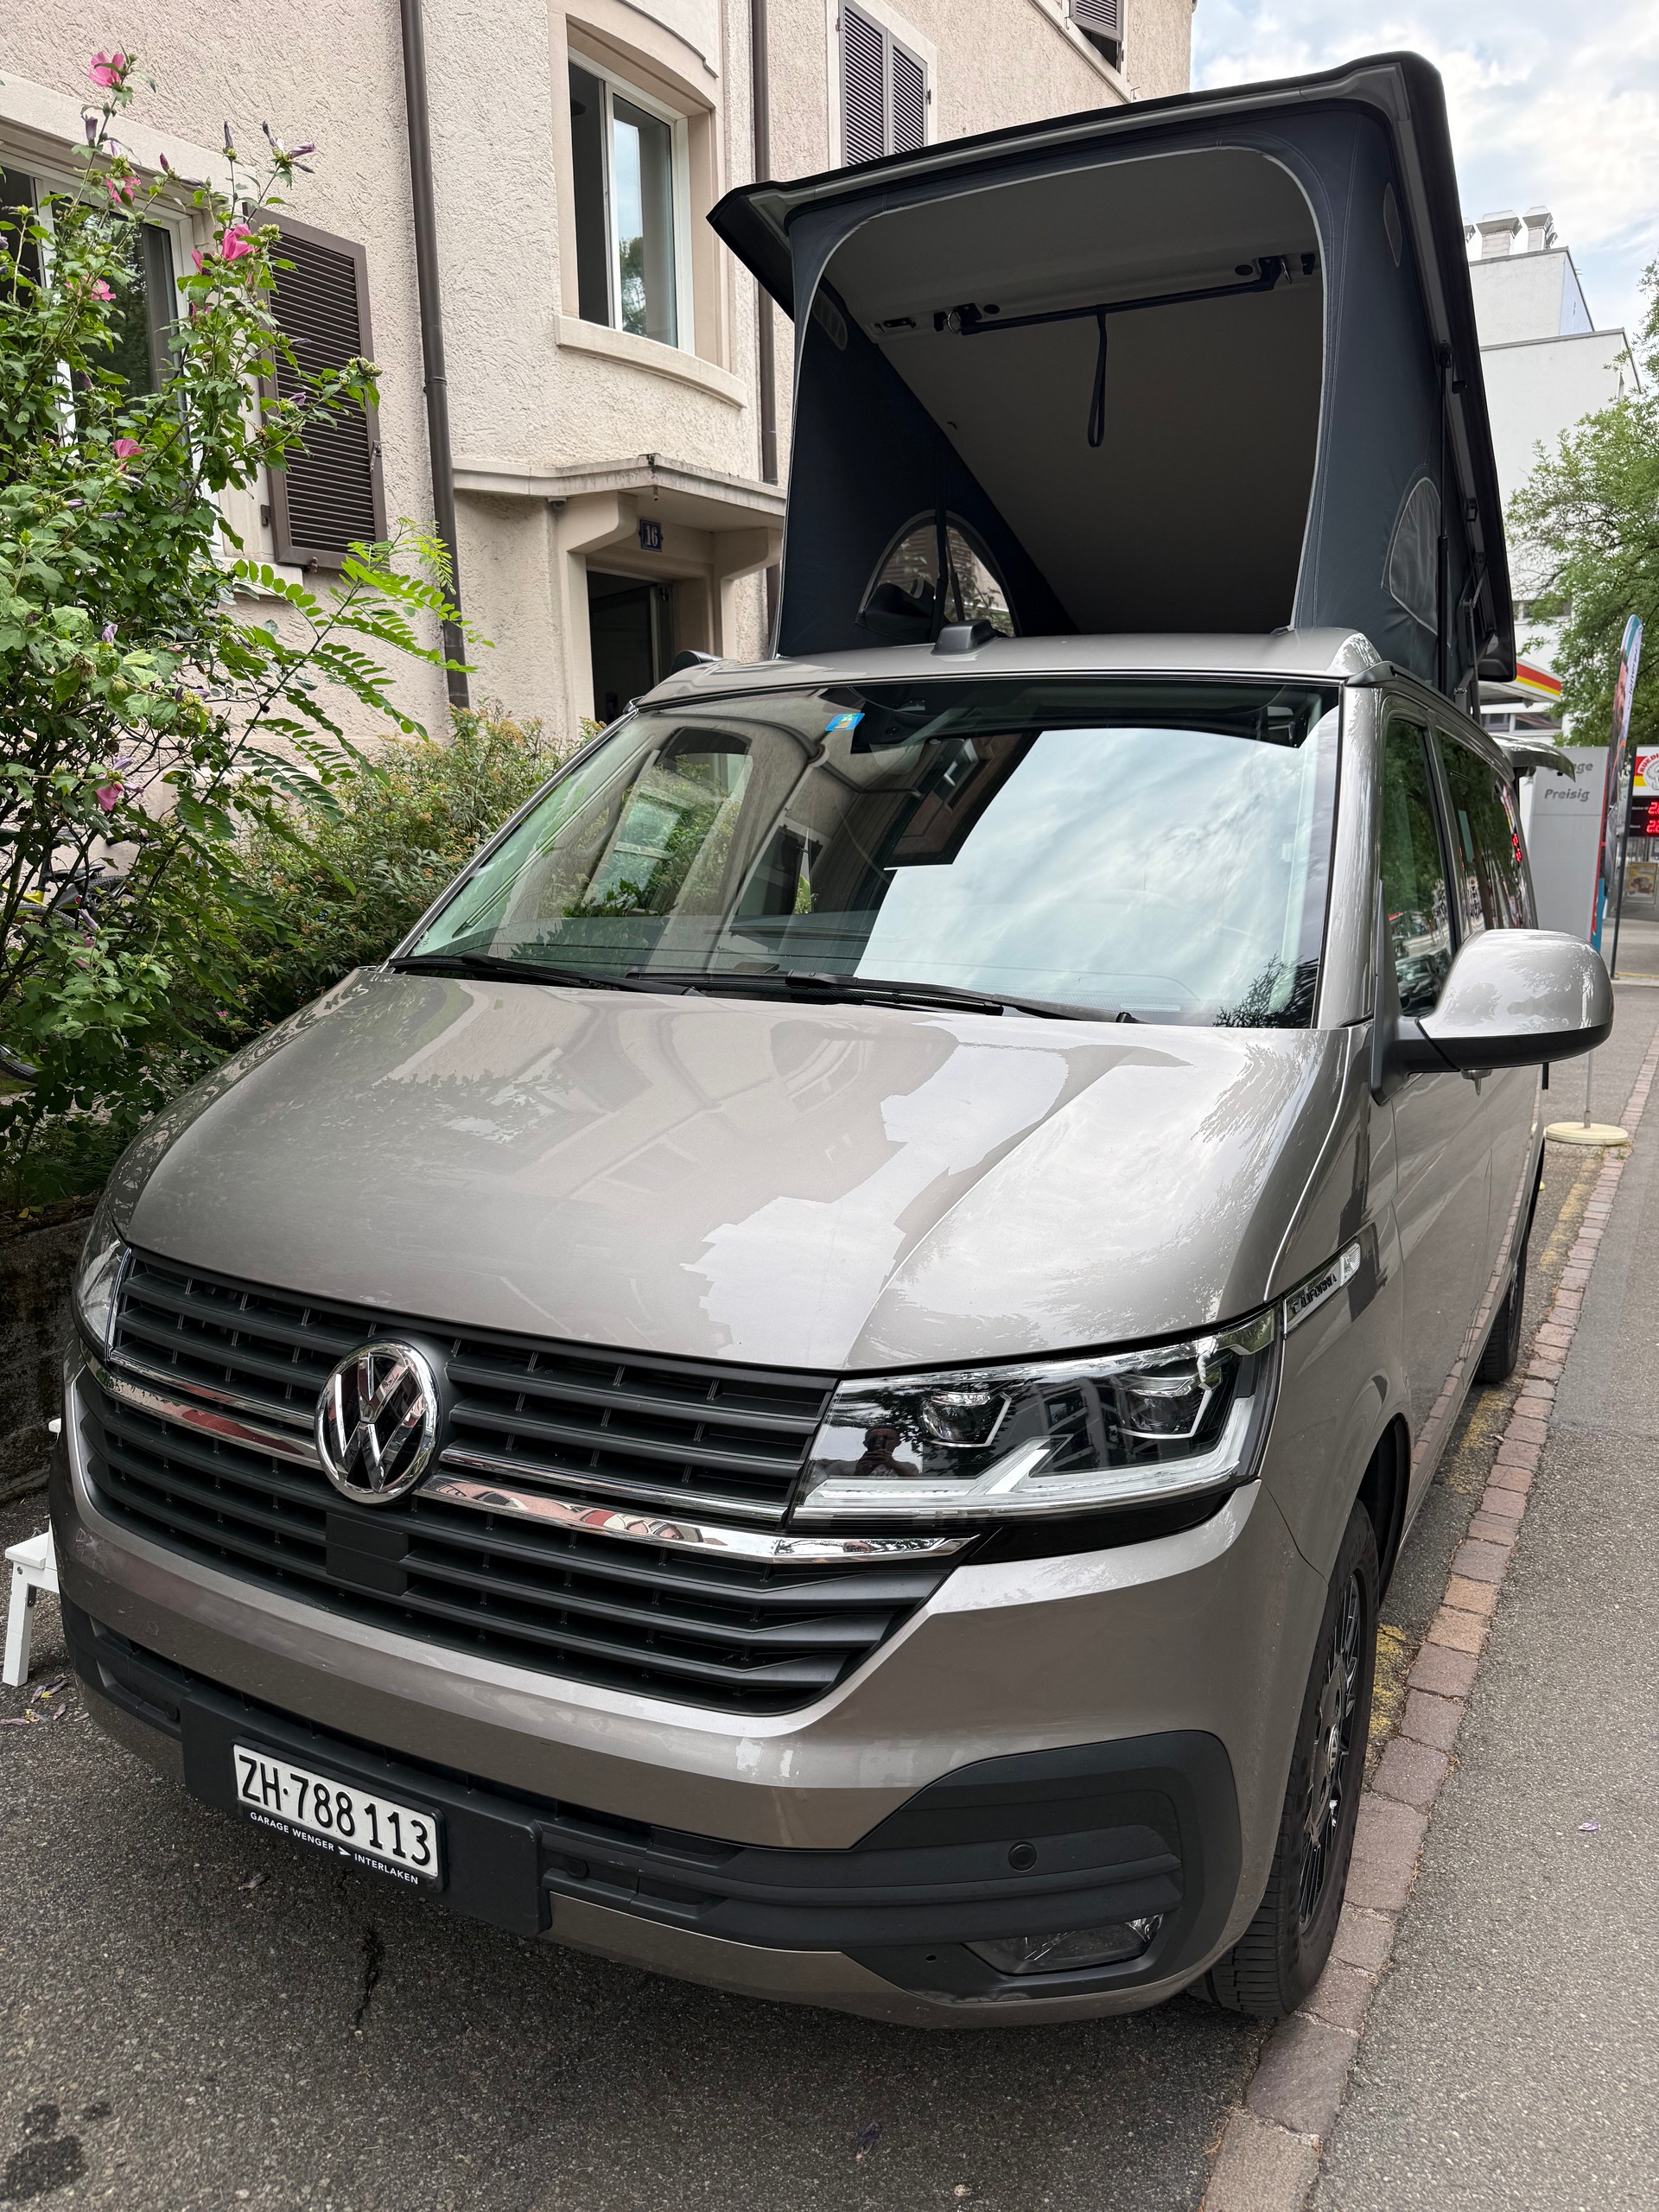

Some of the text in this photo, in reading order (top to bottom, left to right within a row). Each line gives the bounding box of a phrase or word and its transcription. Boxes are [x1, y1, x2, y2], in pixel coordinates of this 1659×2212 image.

[645, 524, 658, 547] 16
[1544, 788, 1590, 802] Preisig
[250, 1811, 418, 1885] GARAGE WENGER INTERLAKEN
